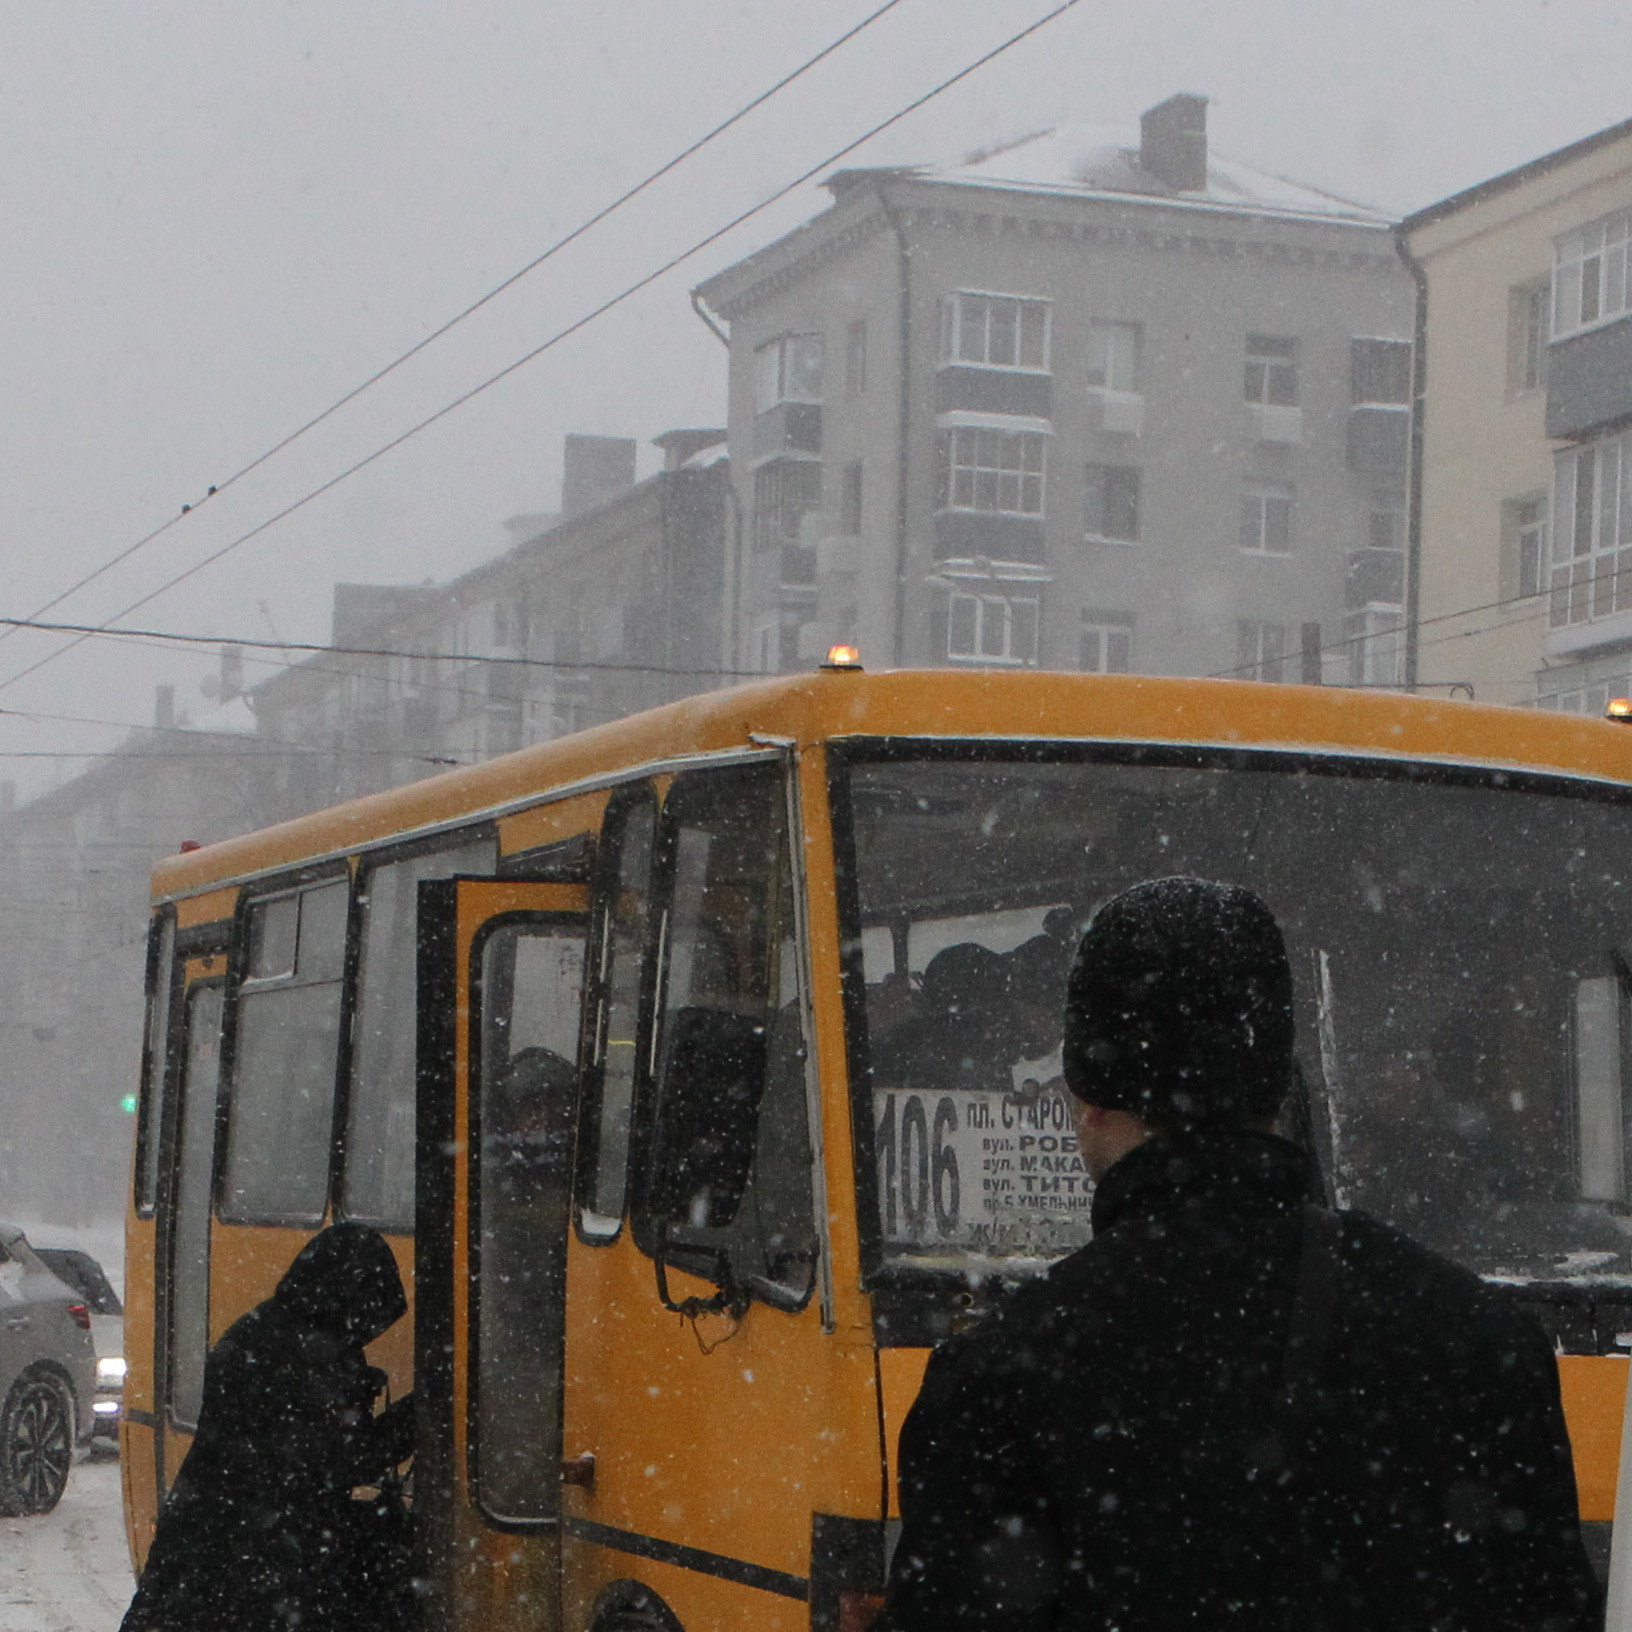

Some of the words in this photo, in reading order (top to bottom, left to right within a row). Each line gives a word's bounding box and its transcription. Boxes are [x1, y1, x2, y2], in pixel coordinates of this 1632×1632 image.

[983, 1138, 1014, 1155] вул.
[876, 1093, 960, 1240] 106
[983, 1158, 1014, 1175] вул.
[983, 1178, 1015, 1195] вул.
